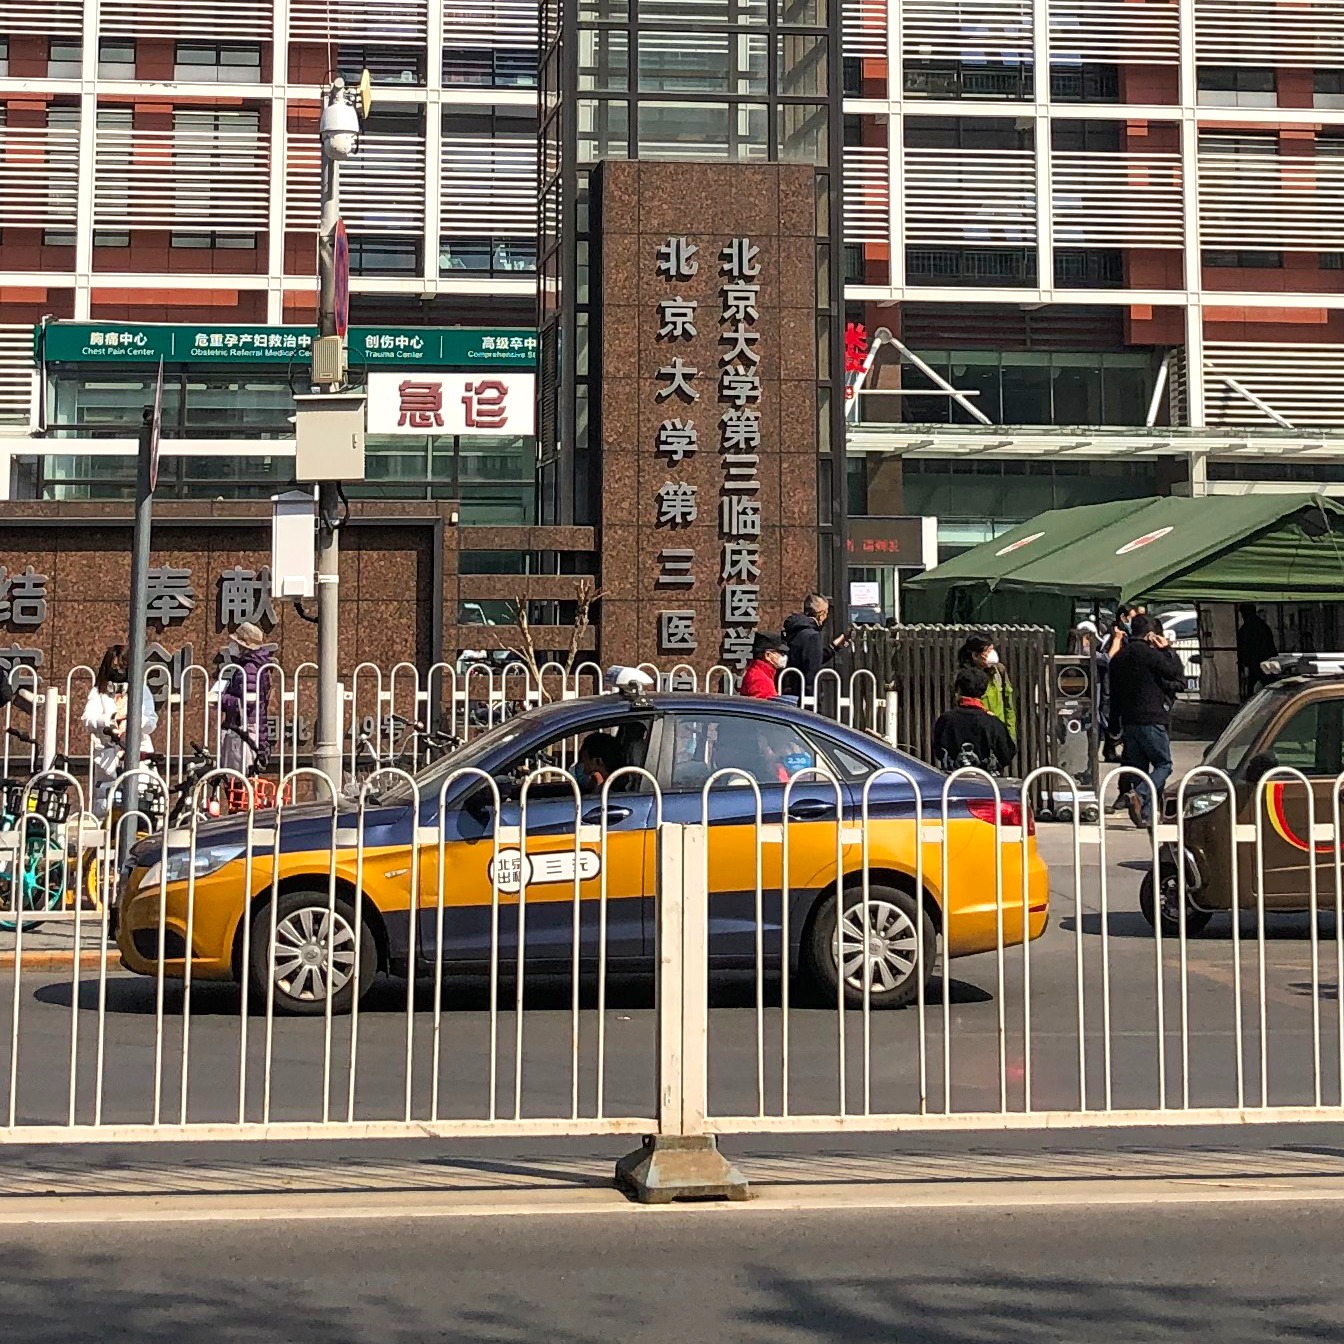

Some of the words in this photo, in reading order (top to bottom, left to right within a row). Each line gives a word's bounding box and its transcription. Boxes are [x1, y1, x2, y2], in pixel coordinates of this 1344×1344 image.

[90, 332, 148, 346] 胸痛中心
[365, 335, 424, 349] 创伤中心
[82, 347, 106, 356] Chest
[107, 347, 126, 356] Pain
[127, 347, 155, 356] Center
[364, 350, 395, 358] Trauma
[396, 350, 424, 358] Center
[397, 379, 509, 429] 急诊
[722, 237, 761, 693] 北京大学第三临床医学
[146, 564, 279, 626] 奉献
